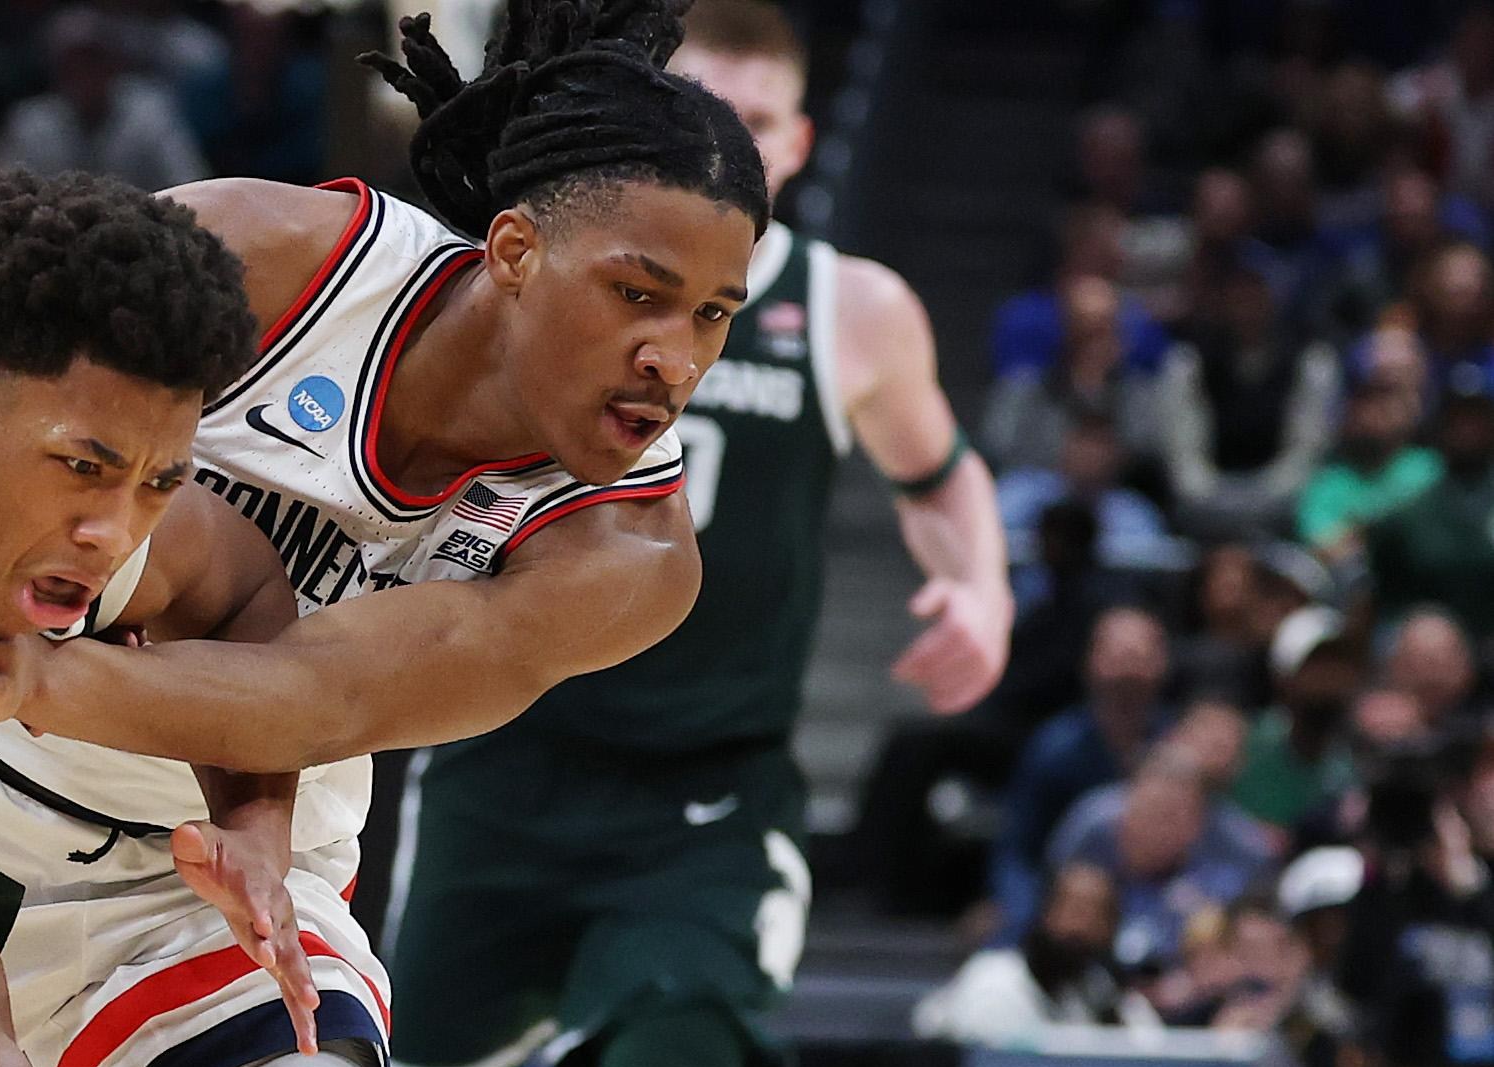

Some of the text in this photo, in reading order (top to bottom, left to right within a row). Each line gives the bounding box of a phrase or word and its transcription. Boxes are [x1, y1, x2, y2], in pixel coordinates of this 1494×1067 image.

[293, 389, 333, 429] NCAA
[436, 540, 490, 570] EAS
[447, 529, 497, 555] BIG
